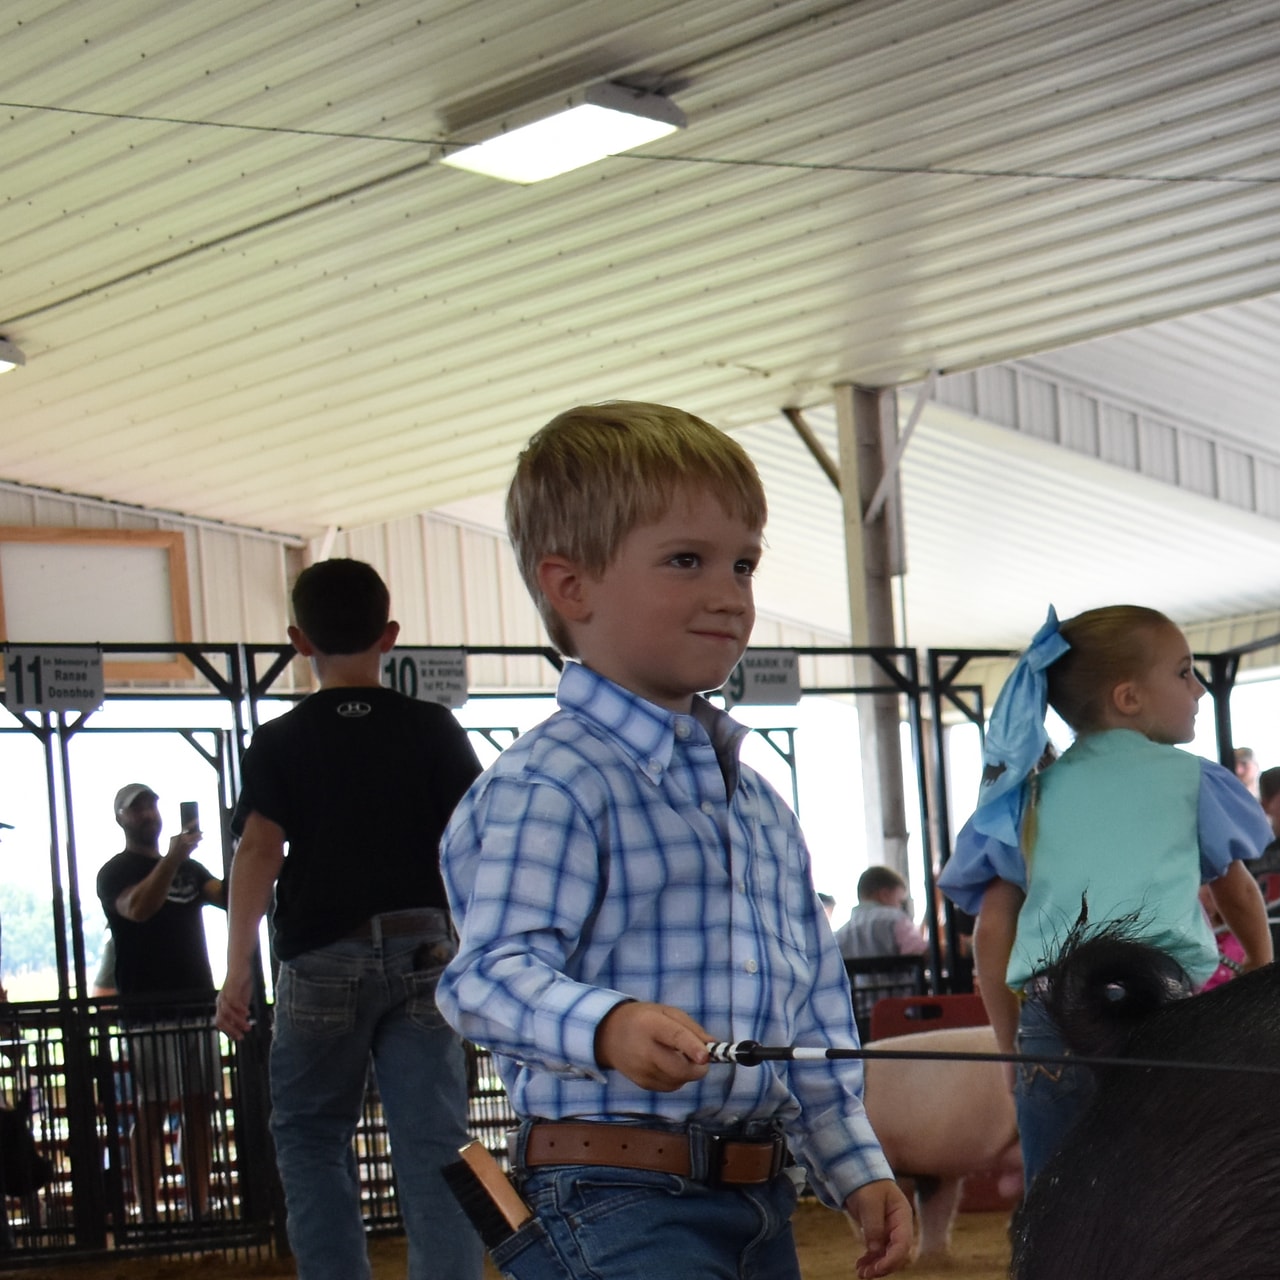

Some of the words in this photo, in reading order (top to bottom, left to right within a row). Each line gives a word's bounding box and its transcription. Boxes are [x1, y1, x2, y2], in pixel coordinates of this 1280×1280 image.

[43, 658, 51, 666] In
[54, 658, 89, 668] Memory
[91, 658, 100, 666] of
[8, 656, 42, 704] 11
[55, 670, 87, 682] Ranae
[384, 656, 418, 700] 10
[729, 661, 745, 702] 9
[754, 673, 787, 684] FARM
[48, 686, 96, 699] Donohoe
